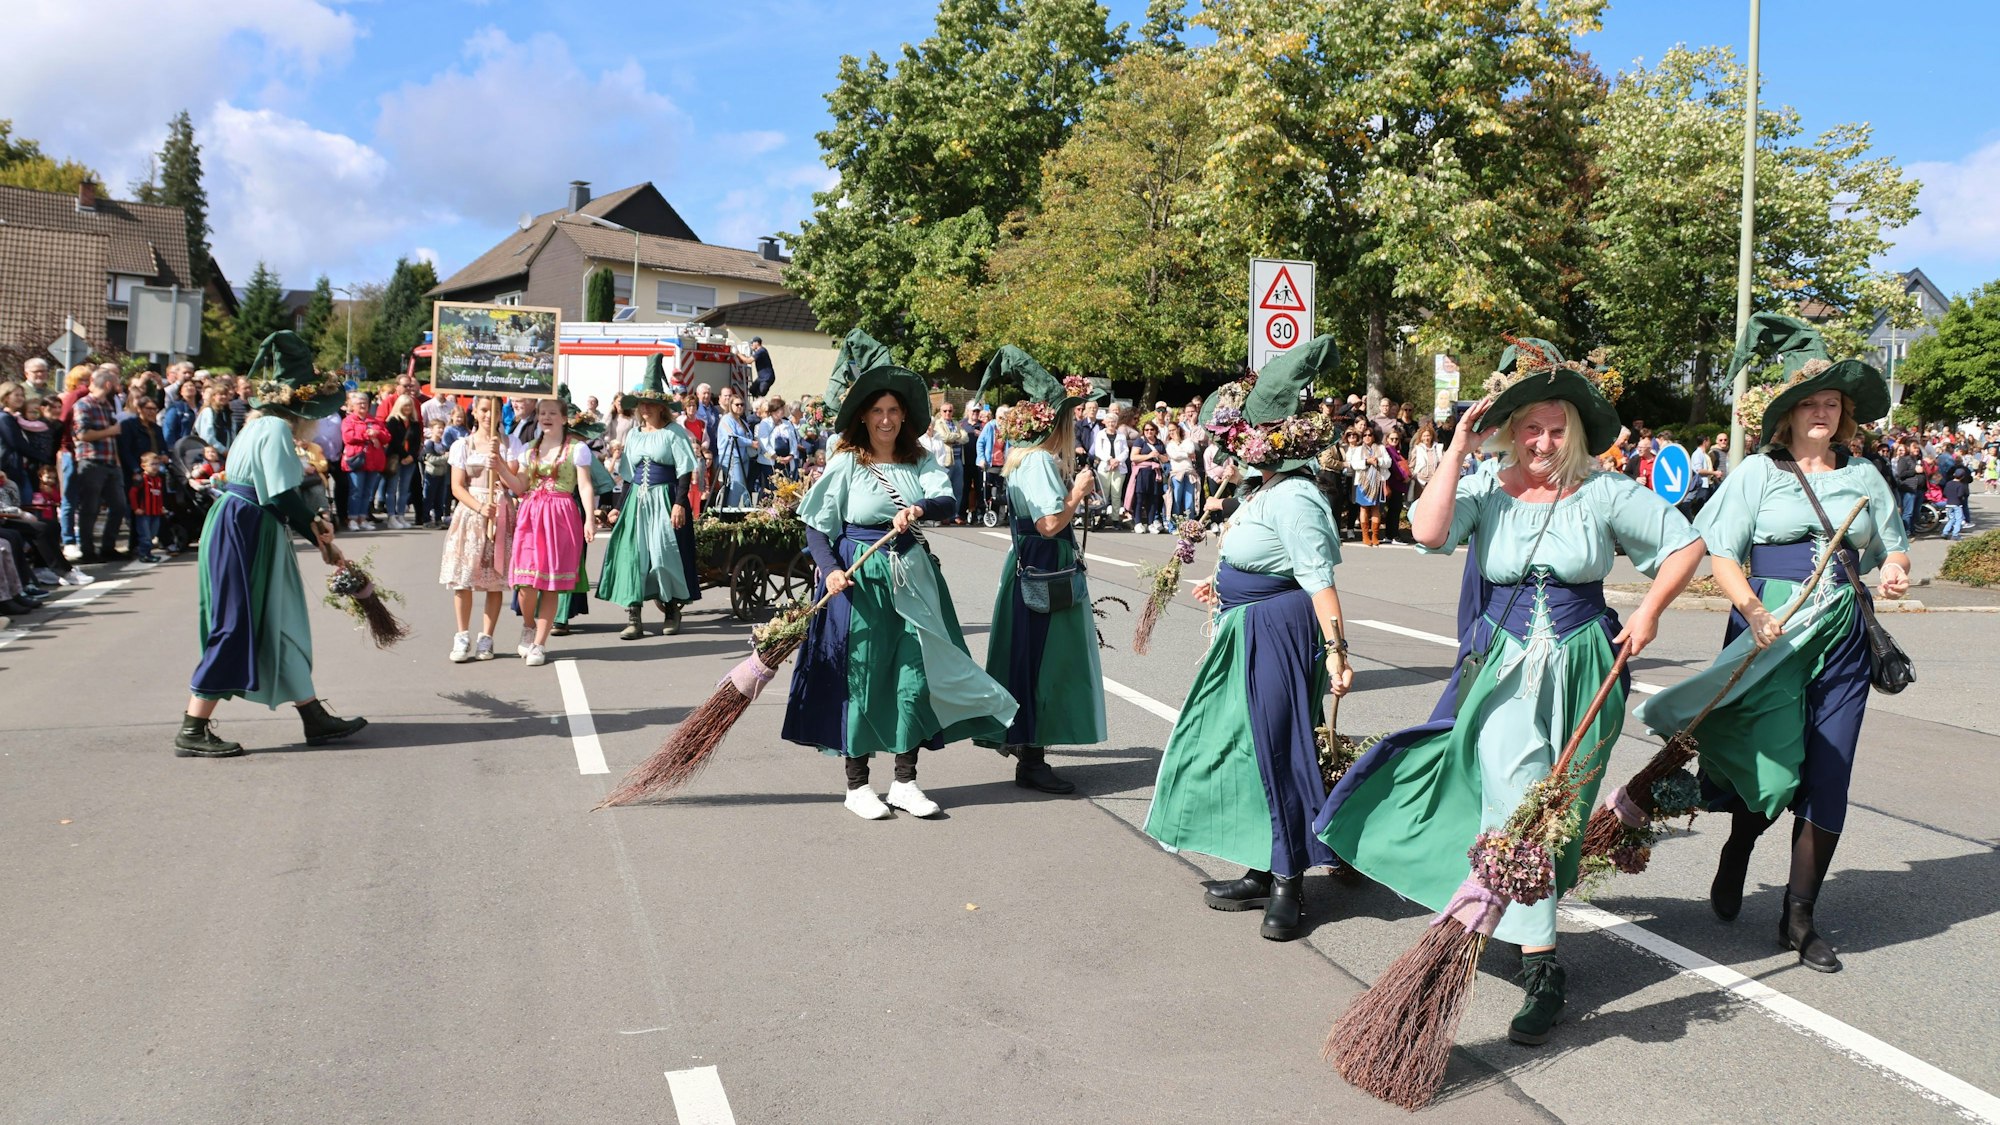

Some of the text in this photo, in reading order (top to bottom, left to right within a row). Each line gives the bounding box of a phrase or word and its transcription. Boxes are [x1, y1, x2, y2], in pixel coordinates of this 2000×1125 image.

[1273, 322, 1292, 339] 30
[454, 339, 472, 350] Wir
[513, 343, 539, 353] unsere
[442, 355, 476, 366] Kräuter
[477, 356, 490, 366] ein
[514, 358, 537, 369] wird
[536, 358, 551, 370] der
[451, 370, 539, 388] Schnaps besonders fein
